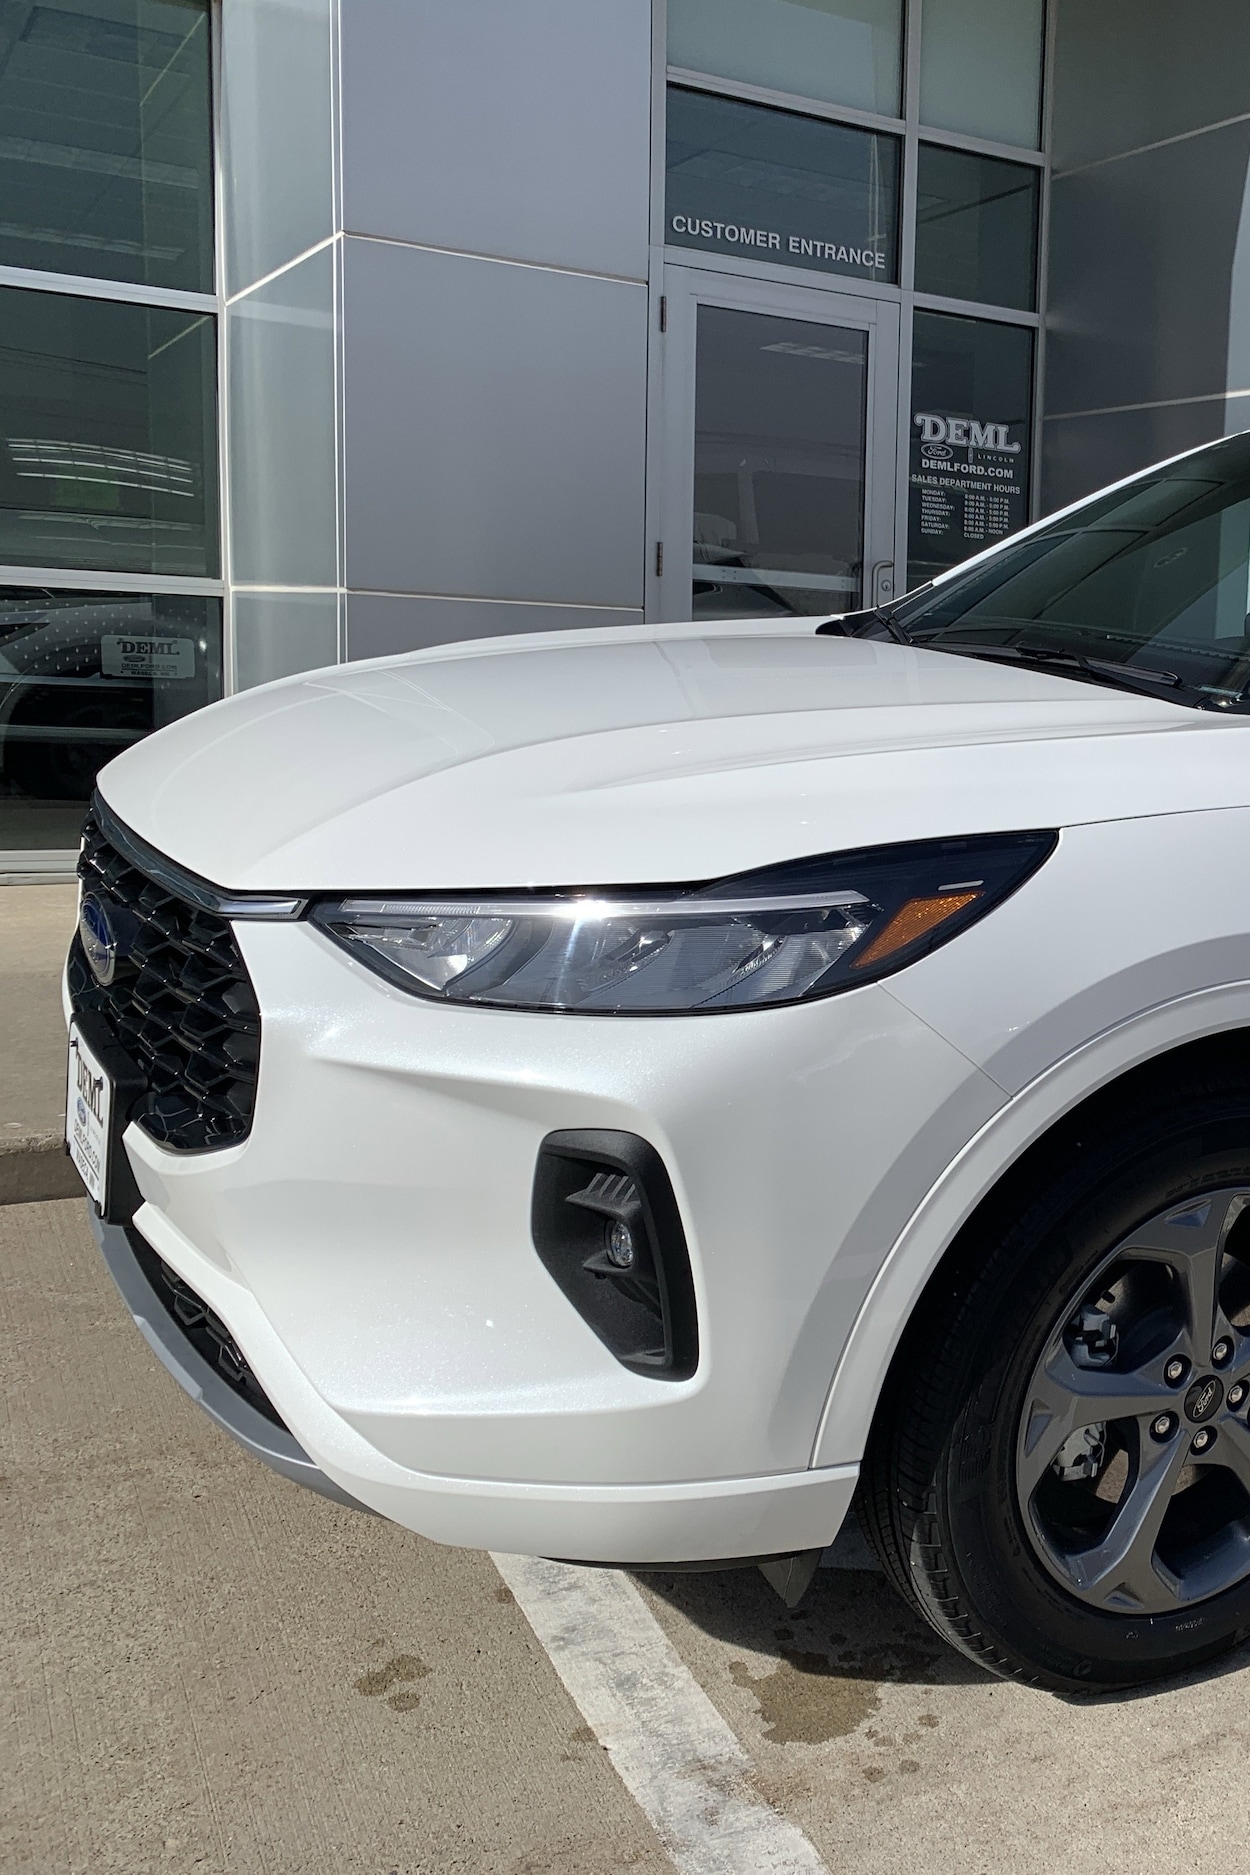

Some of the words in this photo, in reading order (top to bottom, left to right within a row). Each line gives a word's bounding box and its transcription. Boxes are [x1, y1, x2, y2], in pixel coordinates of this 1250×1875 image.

[672, 215, 781, 250] CUSTOMER
[788, 236, 886, 269] ENTRANCE
[914, 413, 1021, 453] DEML
[921, 458, 1014, 479] DEMLFORD.COM
[977, 453, 1015, 463] LINCOLN
[911, 473, 938, 484] SALES
[939, 477, 992, 491] DEPARTMENT
[993, 483, 1021, 494] HOURS
[117, 640, 180, 656] DEML
